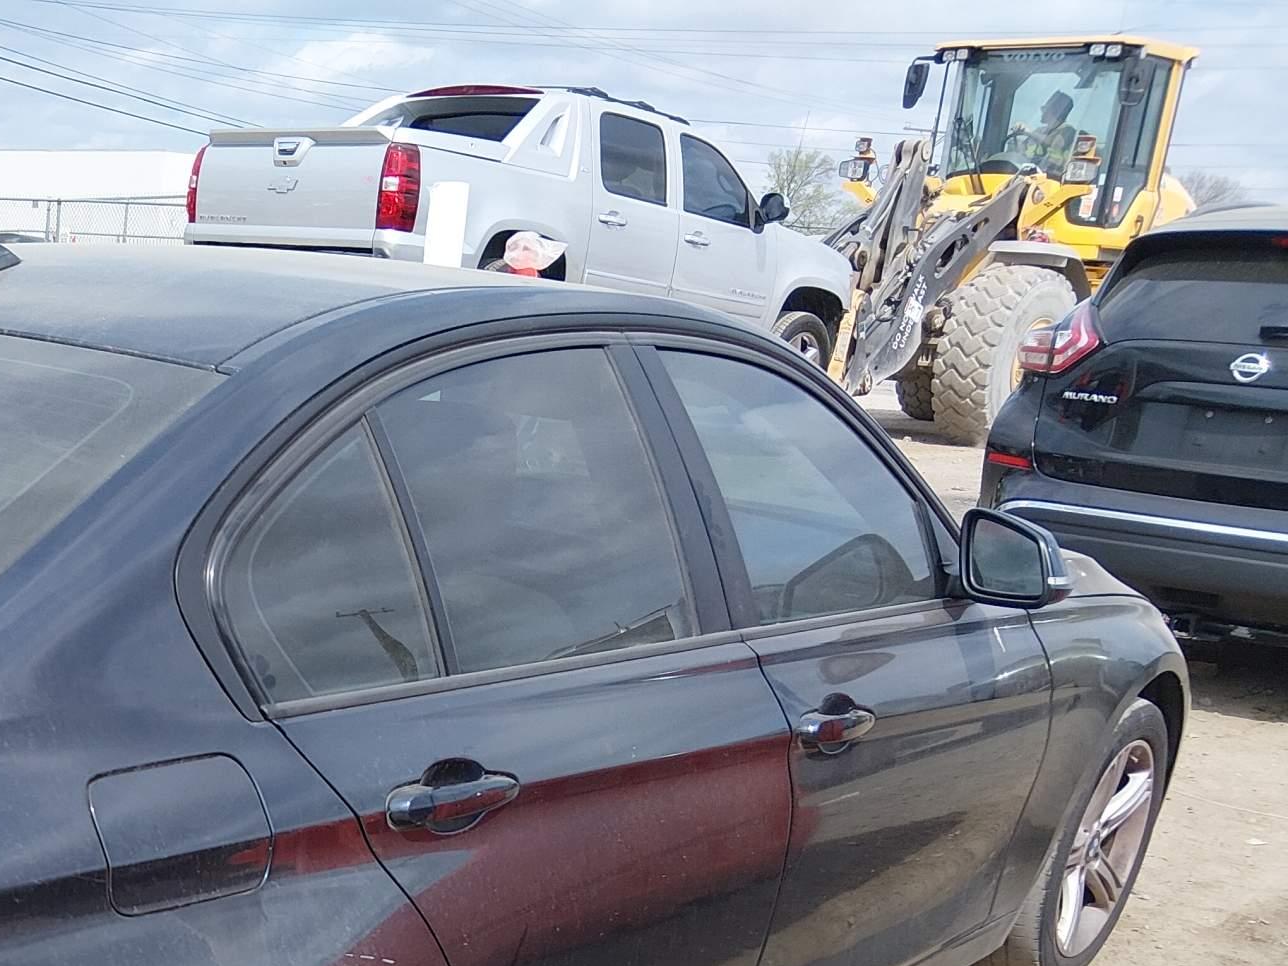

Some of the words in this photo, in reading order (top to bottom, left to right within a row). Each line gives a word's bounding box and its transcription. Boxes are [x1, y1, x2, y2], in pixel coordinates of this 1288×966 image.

[1002, 51, 1066, 62] VOLVO
[892, 332, 902, 350] DO
[1062, 391, 1118, 404] MURANO
